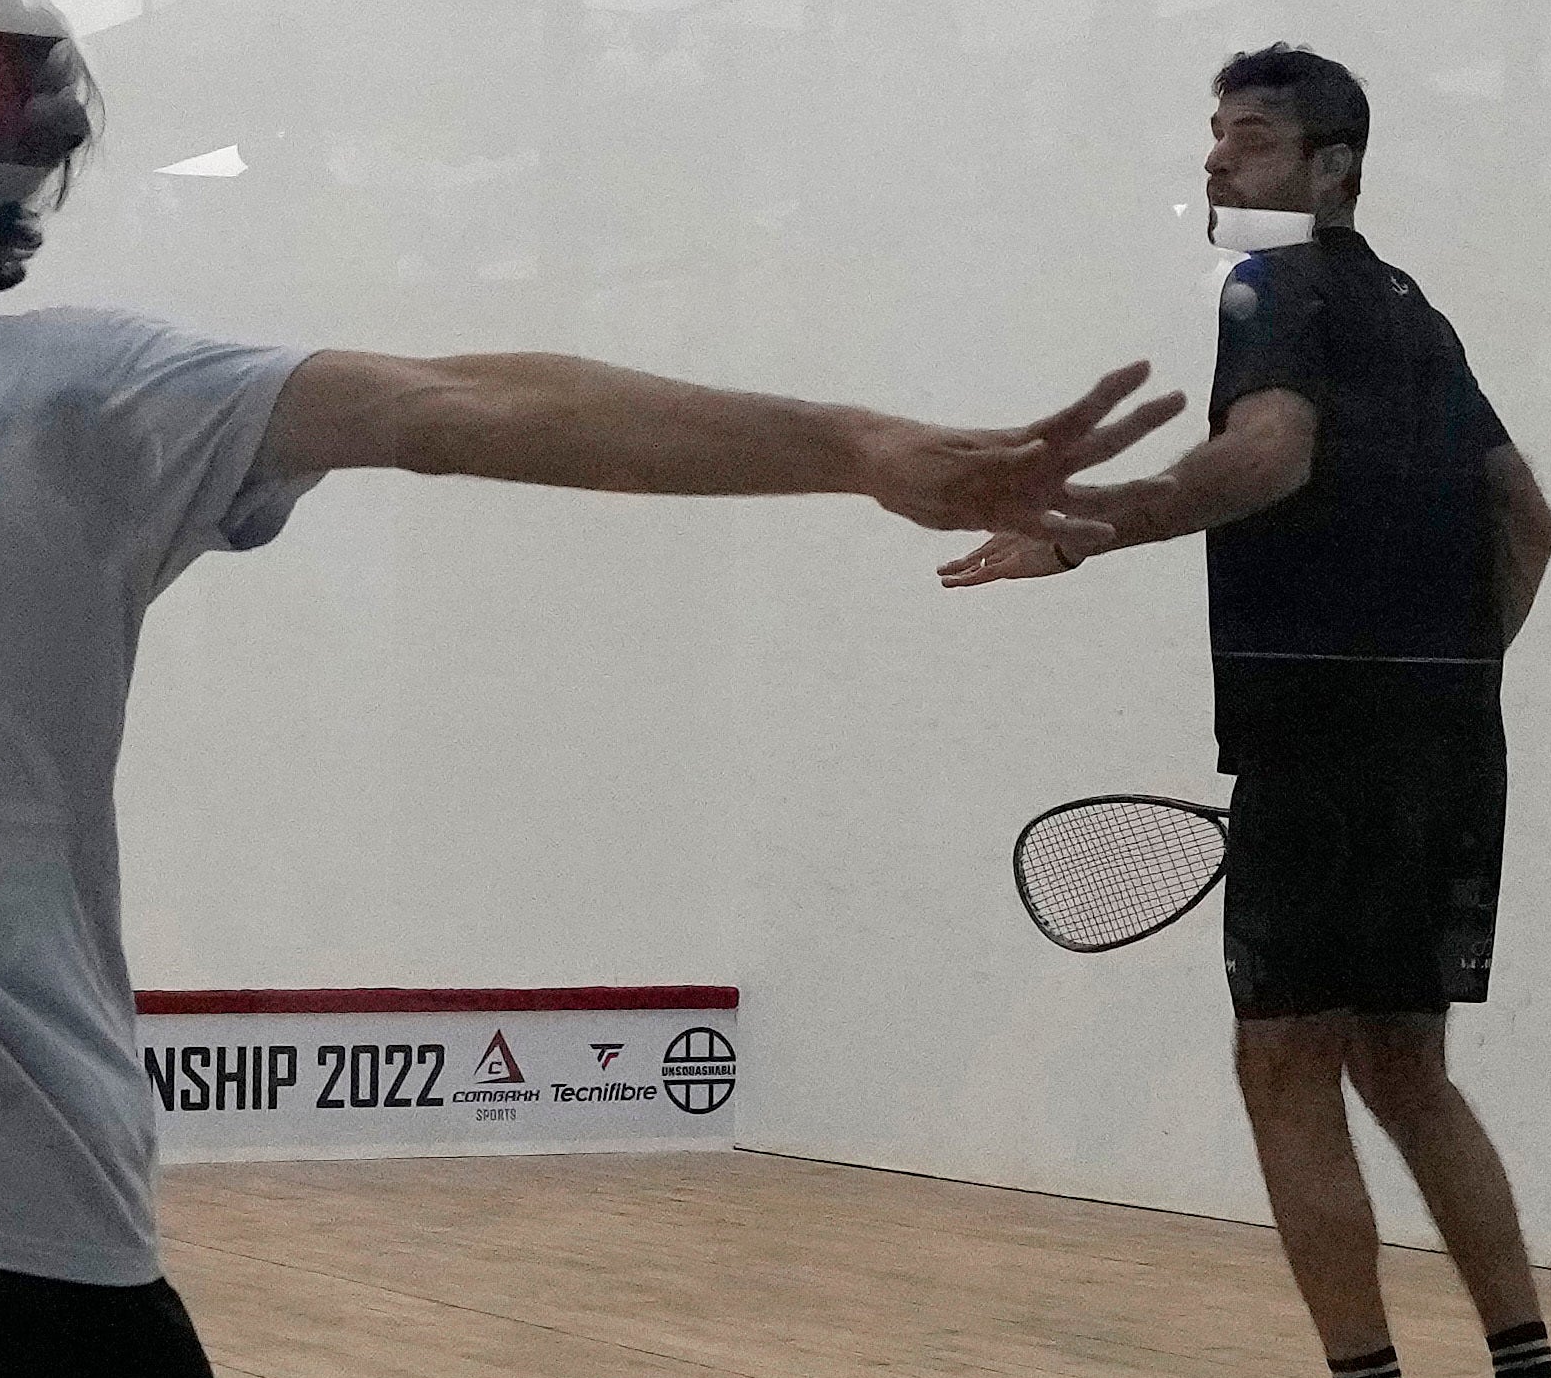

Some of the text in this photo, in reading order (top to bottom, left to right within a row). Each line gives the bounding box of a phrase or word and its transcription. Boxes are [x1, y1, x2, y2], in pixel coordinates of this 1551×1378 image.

[142, 1045, 297, 1111] NSHIP
[318, 1044, 444, 1109] 2022
[551, 1083, 658, 1104] Tecnifibre
[475, 1109, 517, 1122] SPORTS
